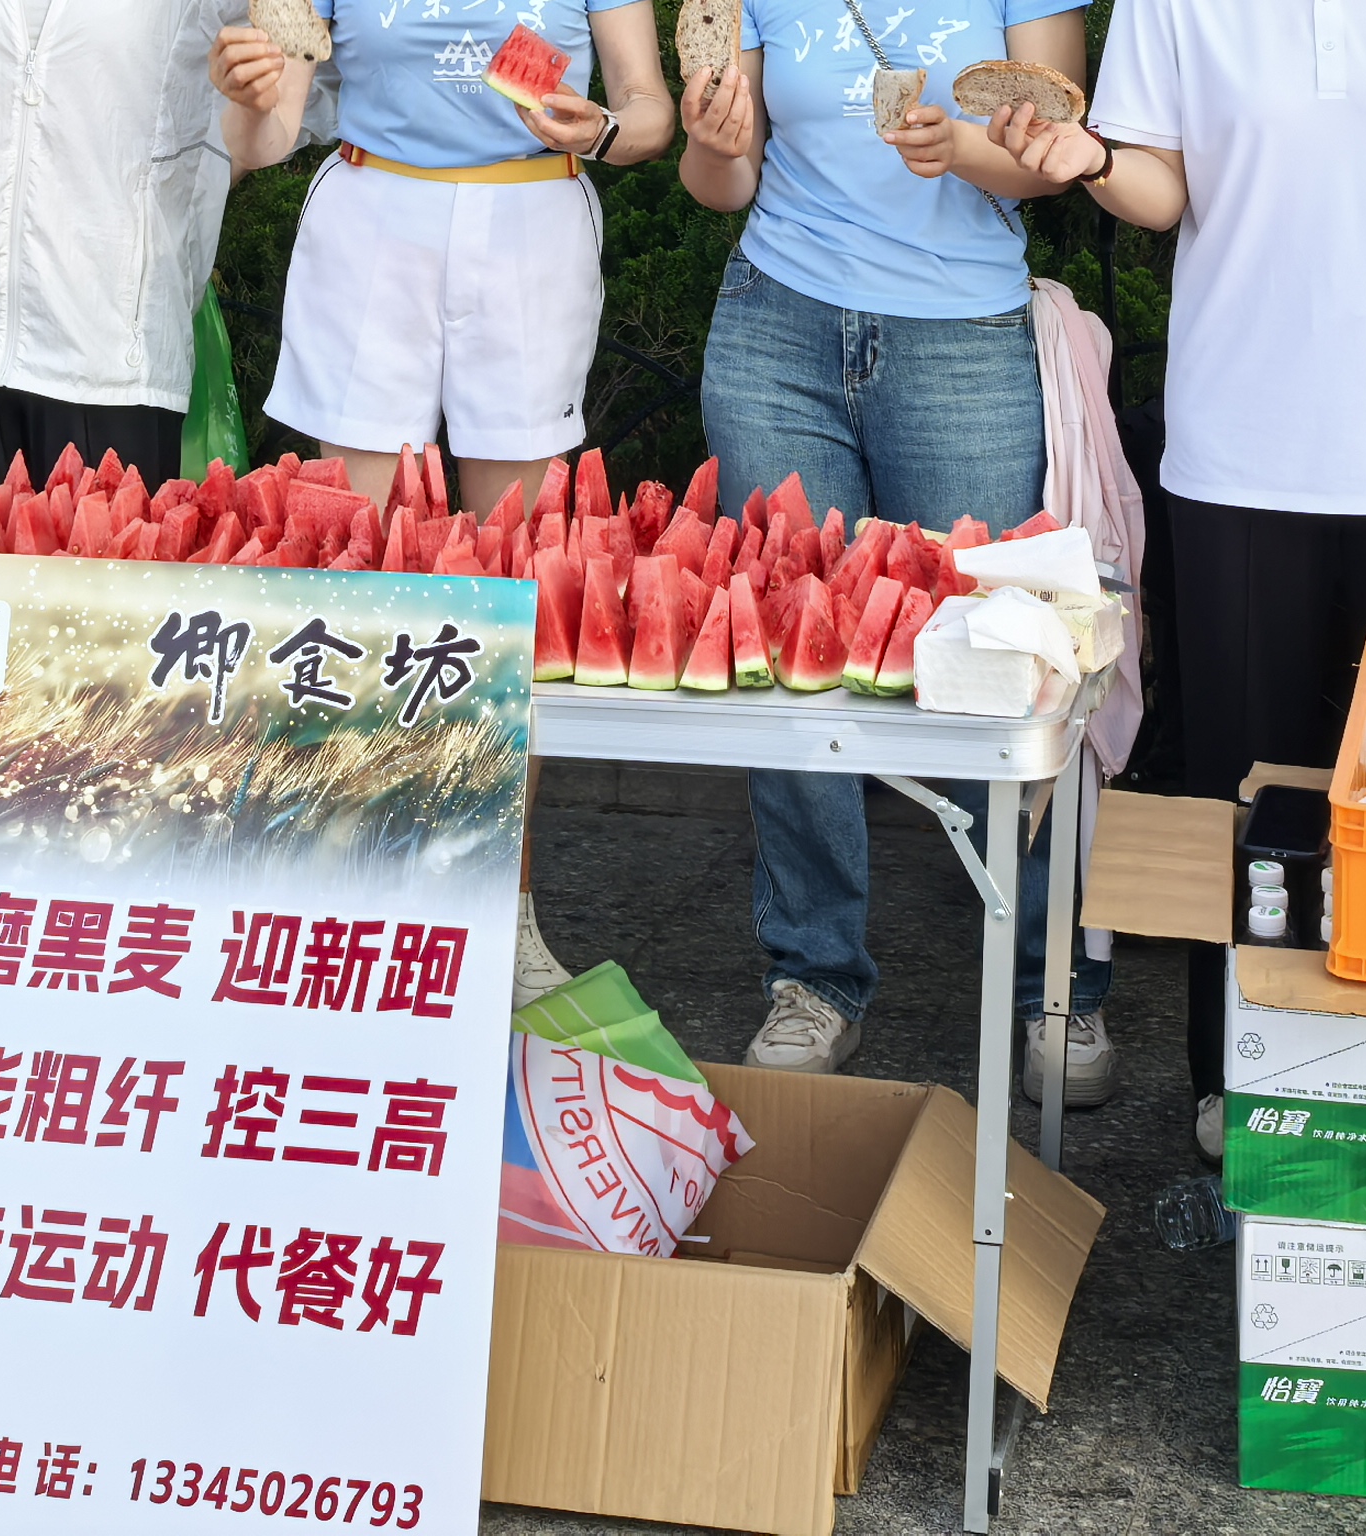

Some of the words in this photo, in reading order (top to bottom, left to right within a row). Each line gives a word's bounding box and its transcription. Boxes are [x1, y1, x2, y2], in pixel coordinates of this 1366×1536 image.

[455, 85, 483, 94] 1901
[212, 910, 469, 1019] 迎新跑
[202, 1066, 457, 1177] 控三高
[194, 1222, 445, 1336] 代餐好
[130, 1458, 423, 1529] 13345026793
